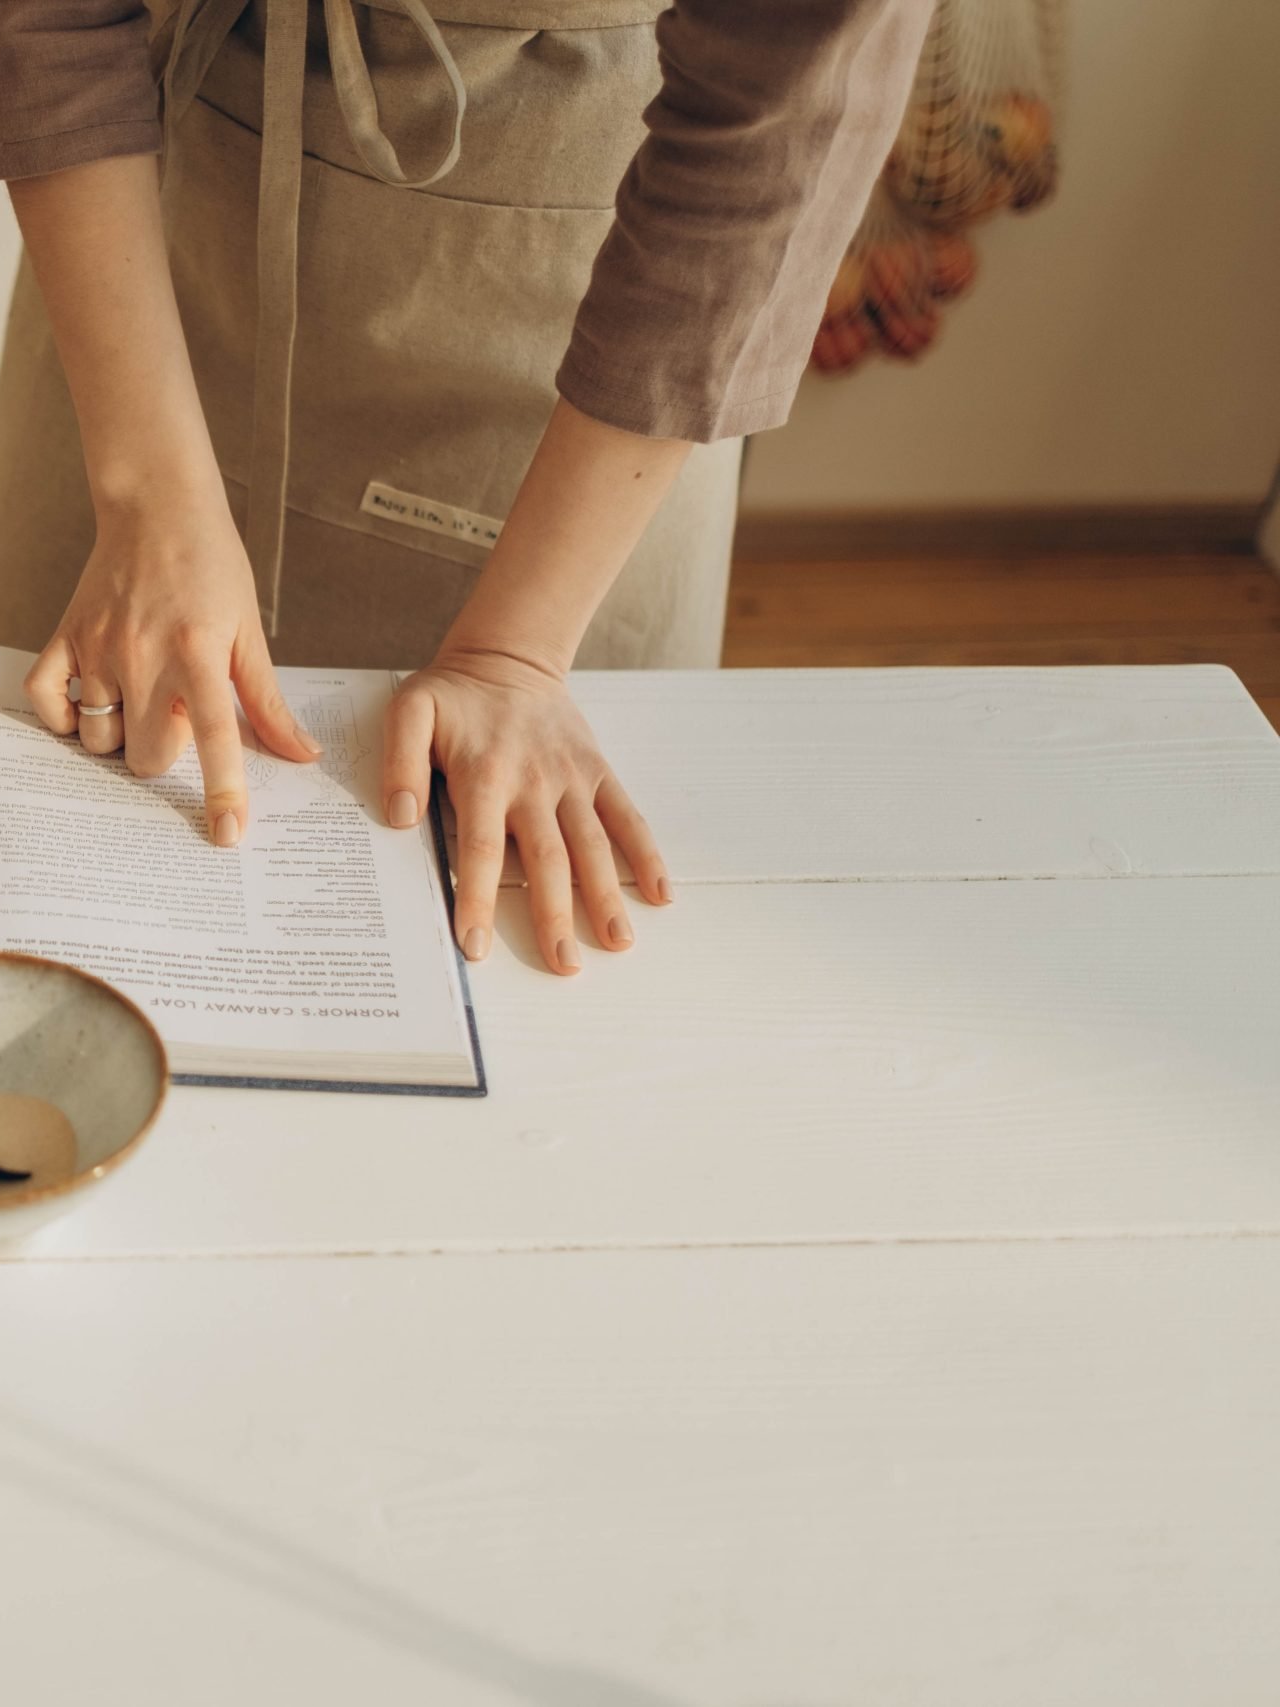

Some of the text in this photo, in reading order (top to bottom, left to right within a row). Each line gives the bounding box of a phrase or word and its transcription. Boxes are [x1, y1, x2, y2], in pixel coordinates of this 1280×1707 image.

[373, 496, 478, 533] Enjoy life, it's
[61, 941, 89, 949] house
[142, 949, 180, 958] reminds
[104, 955, 137, 964] nettles
[89, 964, 124, 973] famous
[164, 962, 203, 970] smoked
[108, 976, 154, 986] mormor's
[150, 998, 400, 1018] MORMOR'S CARAWAY LOAF
